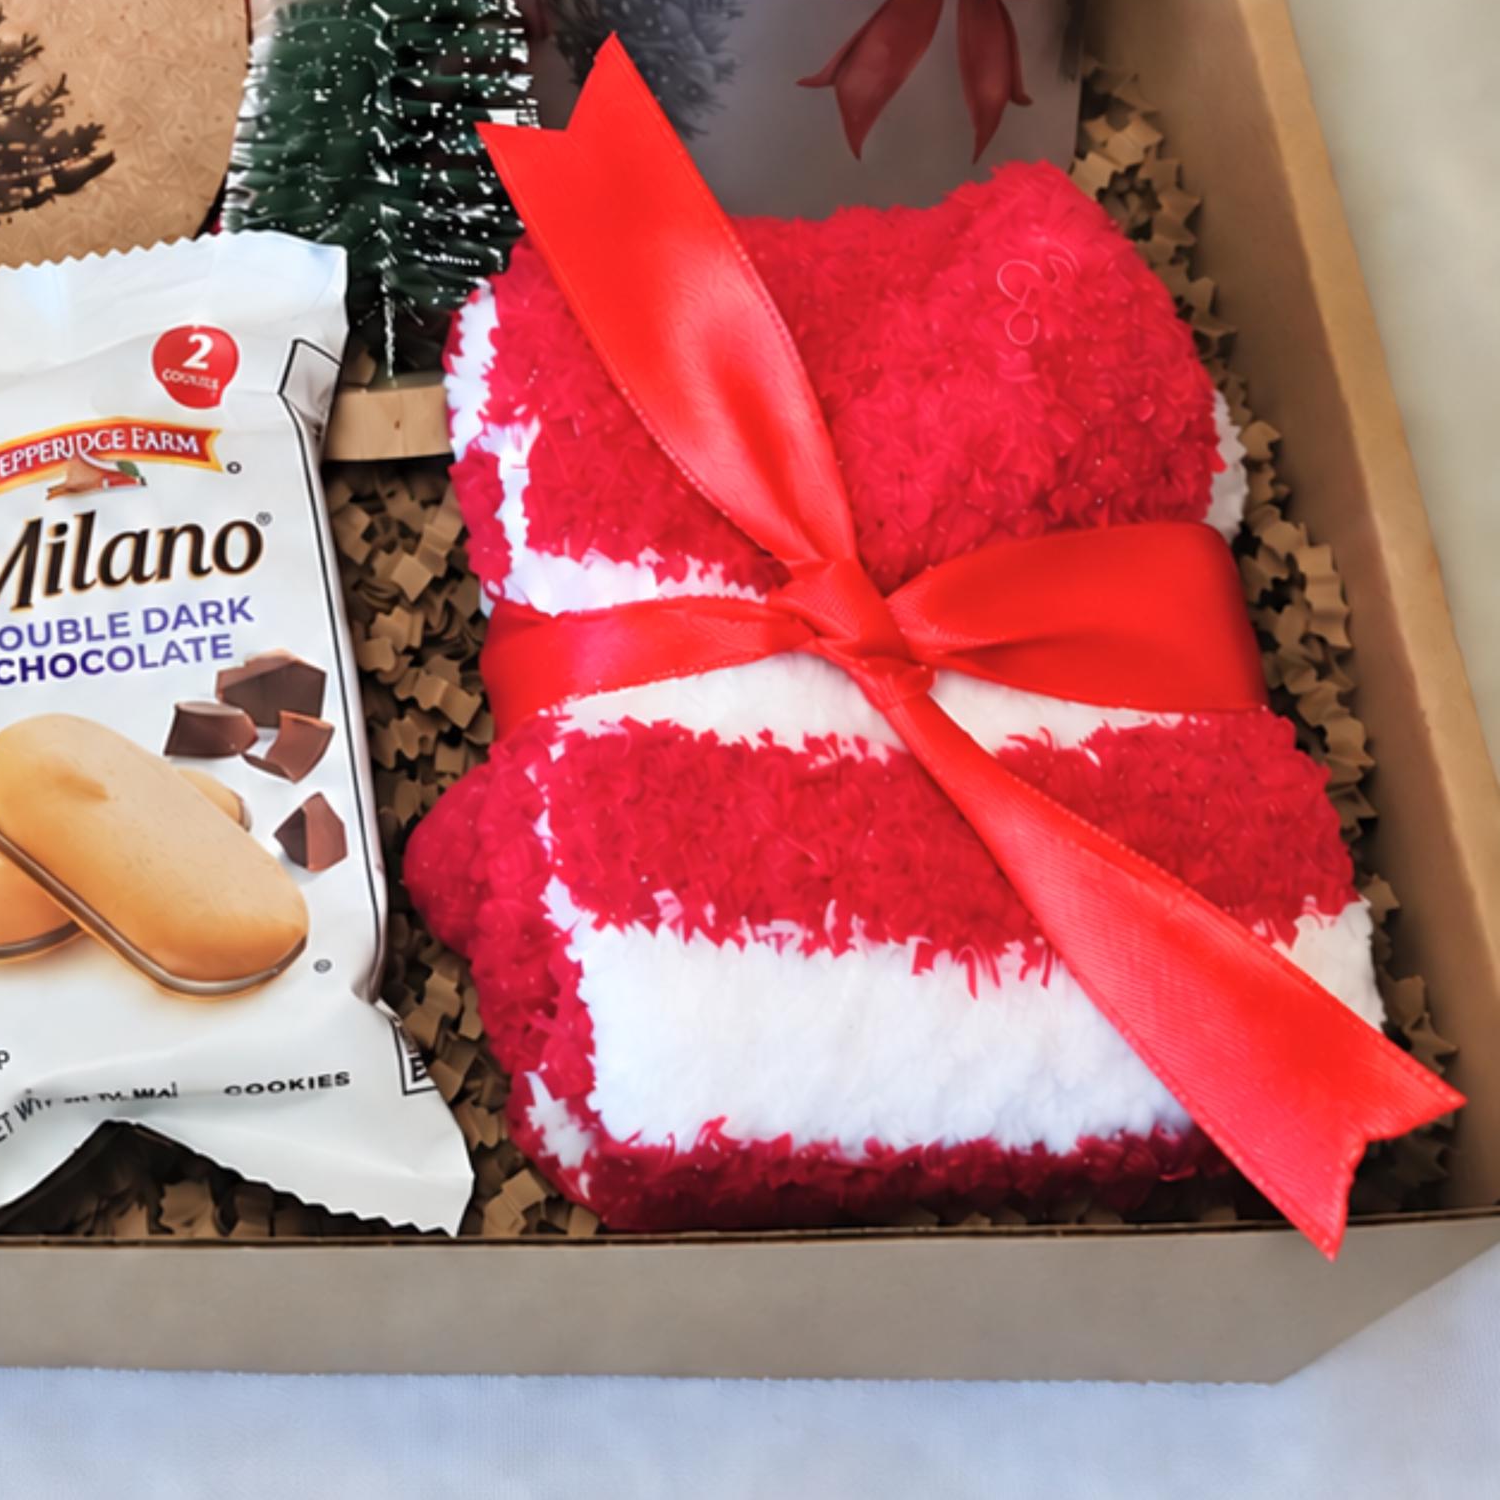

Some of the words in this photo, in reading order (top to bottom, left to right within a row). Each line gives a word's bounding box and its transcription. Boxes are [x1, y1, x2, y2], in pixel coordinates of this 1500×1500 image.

[182, 334, 213, 369] 2
[131, 427, 199, 454] FARM
[142, 596, 255, 635] DARK
[225, 1071, 351, 1096] COOKIES
